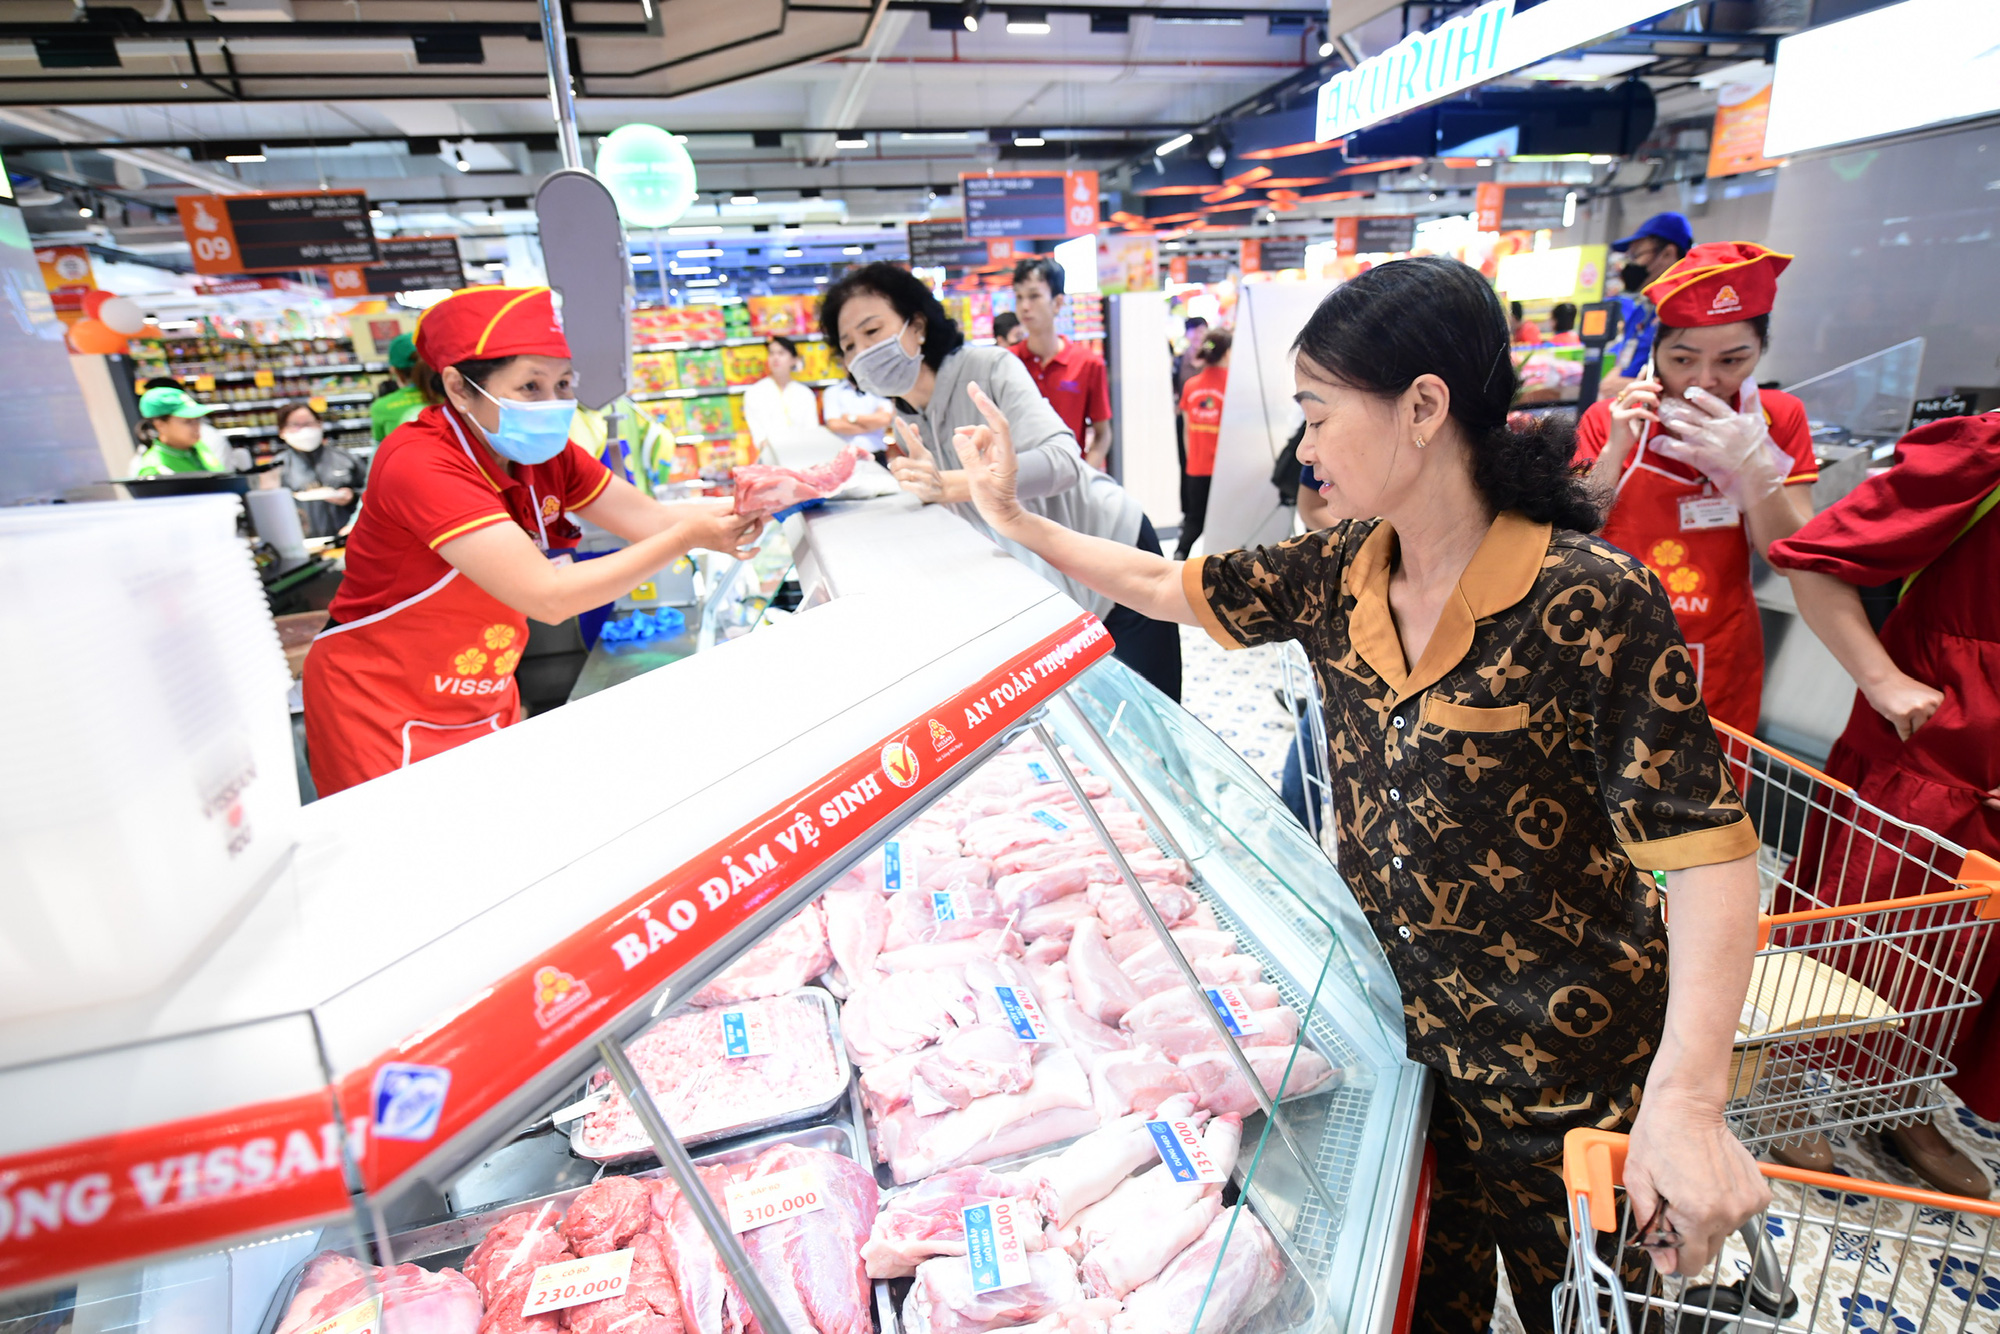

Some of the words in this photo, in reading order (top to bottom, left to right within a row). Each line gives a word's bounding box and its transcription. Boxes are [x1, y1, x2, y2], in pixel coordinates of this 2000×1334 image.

[1325, 7, 1506, 127] AKURUHI
[1070, 206, 1095, 227] 09
[195, 236, 232, 261] 09
[333, 270, 361, 290] 08
[964, 697, 992, 729] AN
[989, 667, 1037, 708] TOÀN
[612, 908, 698, 972] BẢO
[698, 844, 778, 911] ĐẢM
[775, 812, 821, 854] VỆ
[819, 772, 883, 828] SINH
[1160, 1135, 1172, 1149] HEO
[1174, 1122, 1214, 1175] 135.000
[743, 1192, 817, 1223] 310.000
[981, 1228, 992, 1246] HEO
[995, 1204, 1020, 1263] 88.000
[534, 1276, 622, 1306] 230.000
